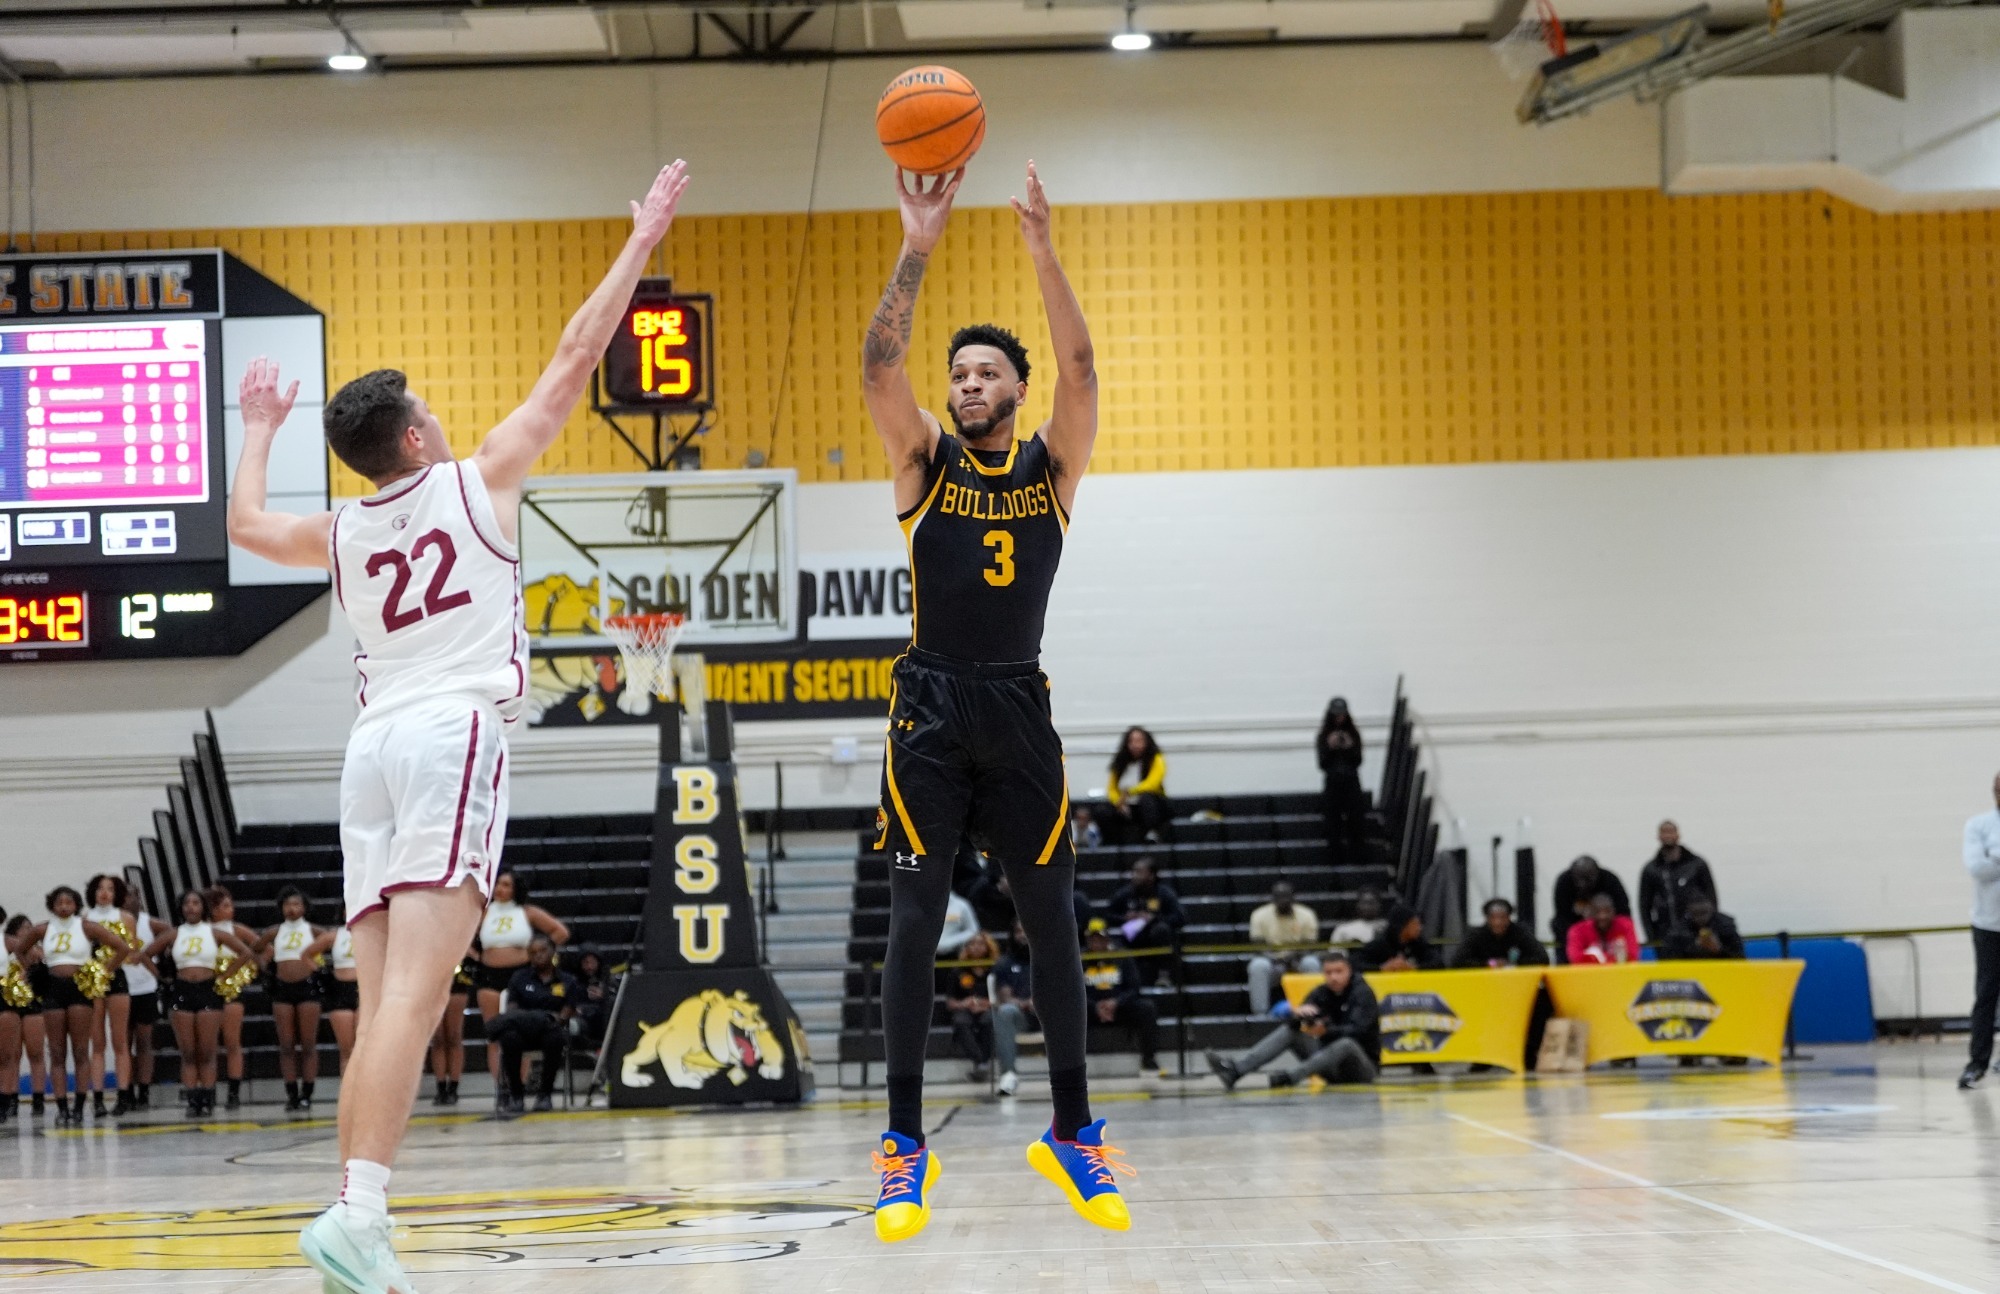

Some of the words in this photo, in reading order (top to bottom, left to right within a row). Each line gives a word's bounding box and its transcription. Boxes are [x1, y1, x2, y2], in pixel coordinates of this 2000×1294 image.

[29, 260, 193, 312] STATE
[642, 334, 691, 395] 15
[940, 482, 1049, 520] BULLDOGS
[364, 528, 473, 633] 22
[983, 530, 1015, 587] 3
[121, 594, 157, 639] 12
[183, 936, 204, 957] B
